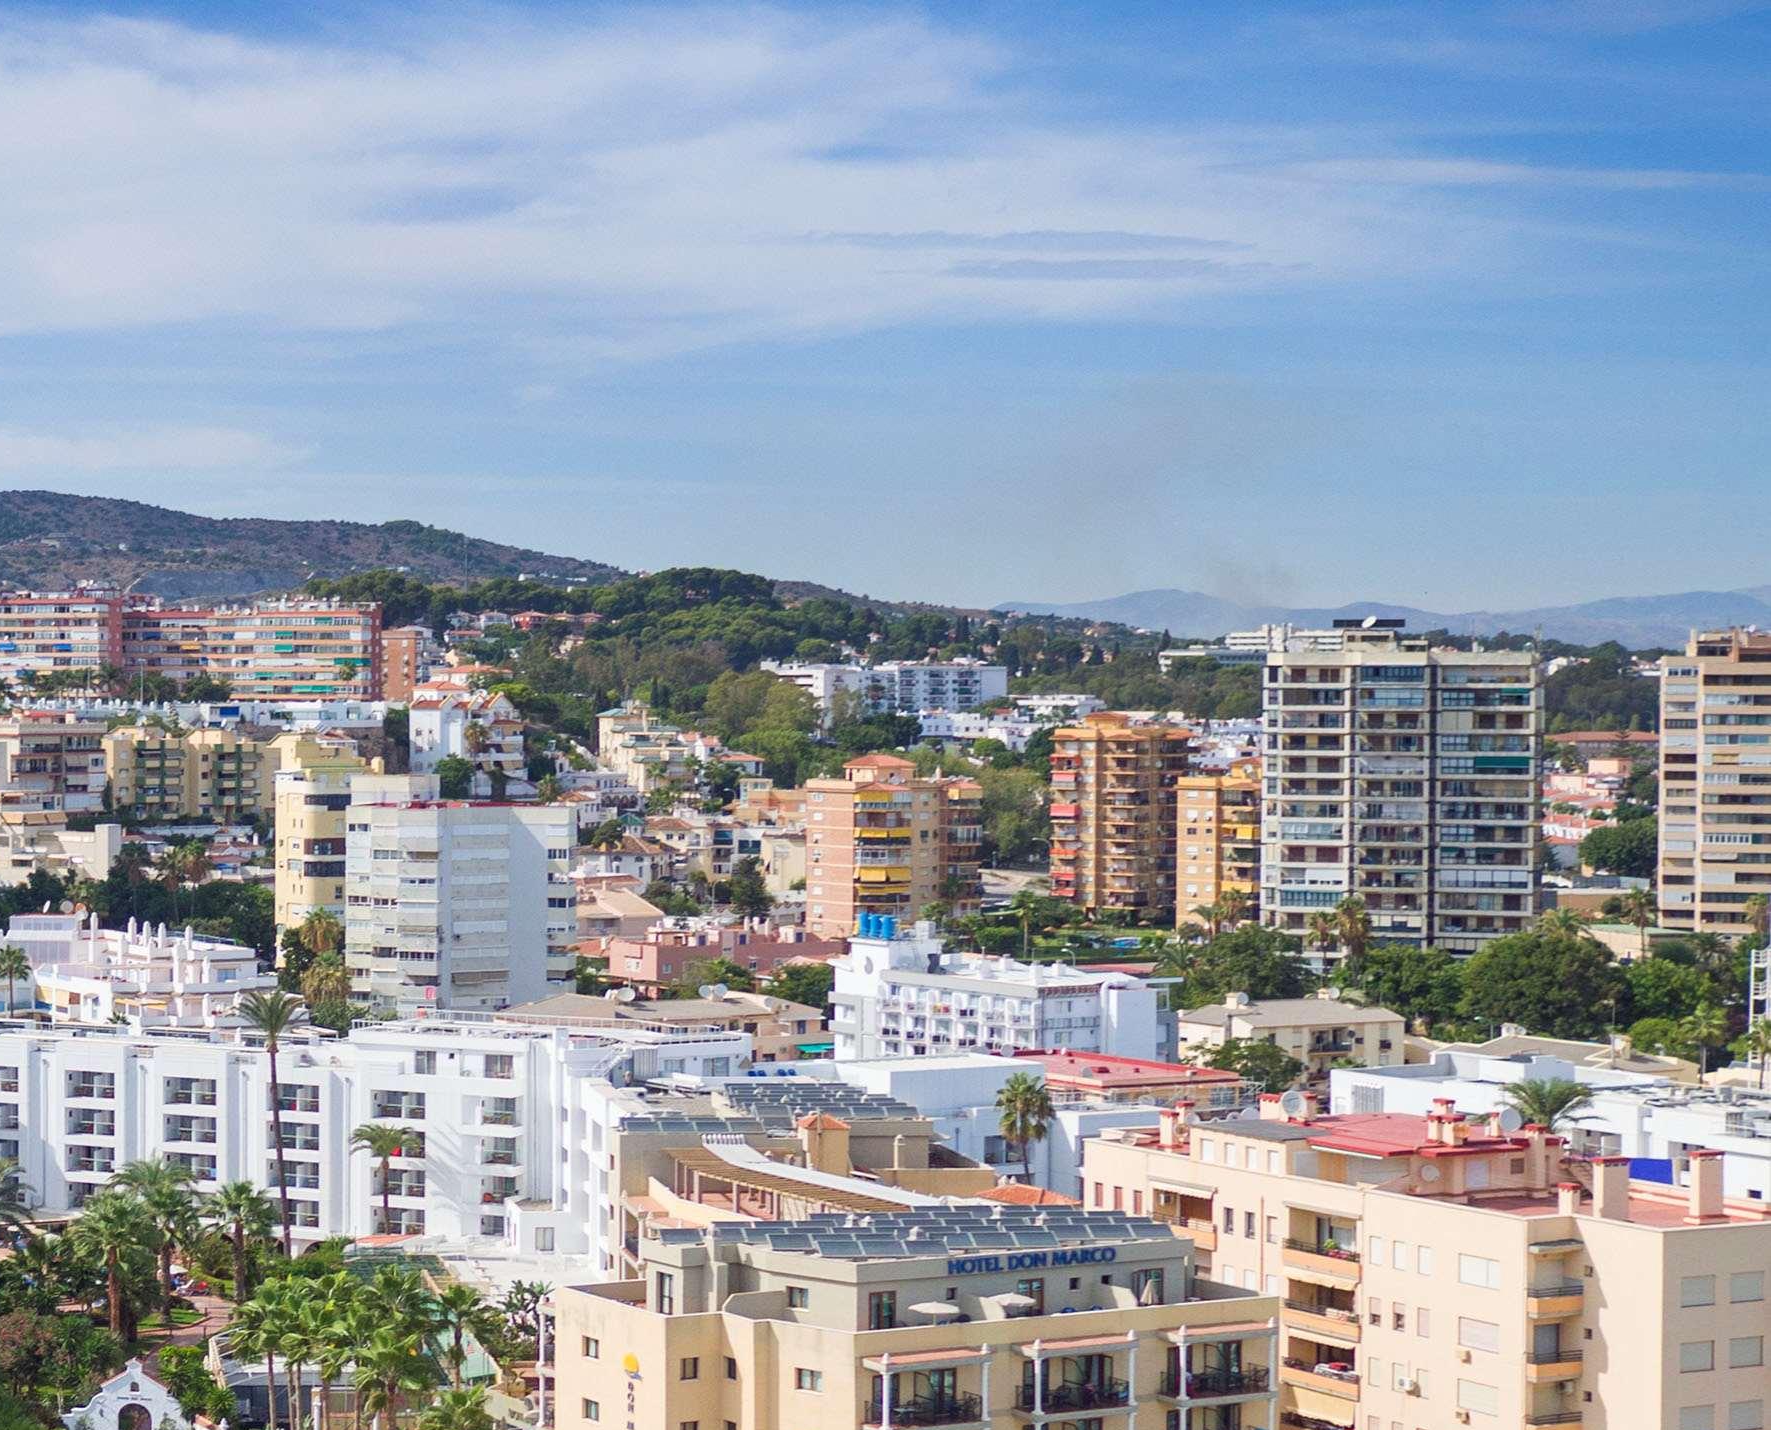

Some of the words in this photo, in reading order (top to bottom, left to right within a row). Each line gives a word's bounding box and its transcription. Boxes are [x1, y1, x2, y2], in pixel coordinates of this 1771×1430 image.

[948, 1256, 1002, 1275] HOTEL
[1008, 1252, 1047, 1271] DON
[1052, 1247, 1116, 1266] MARCO
